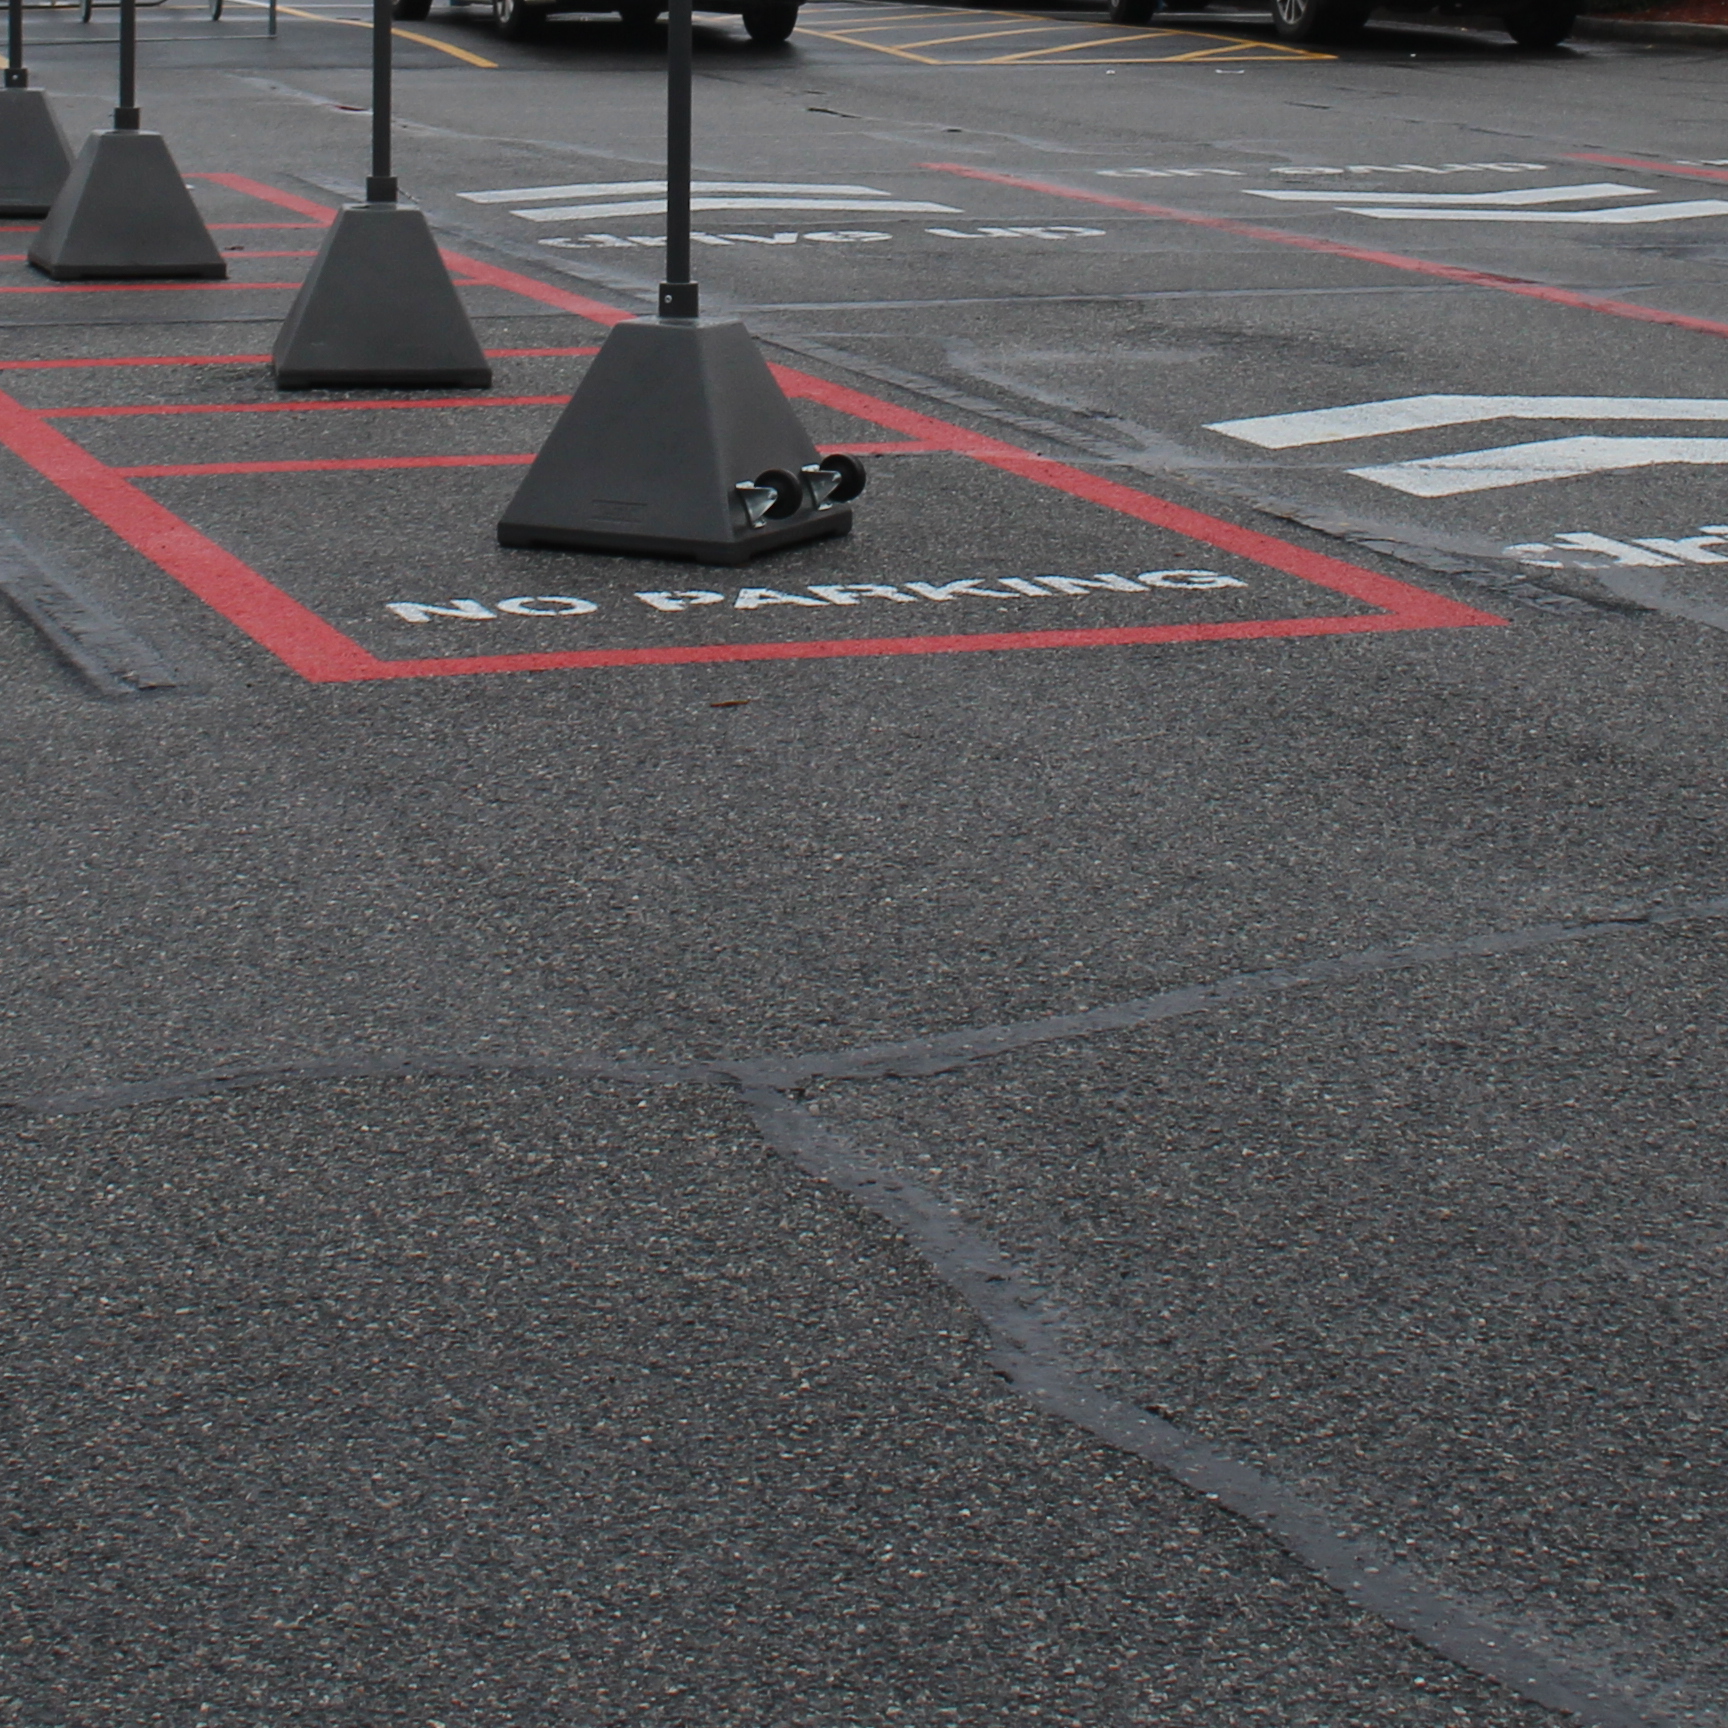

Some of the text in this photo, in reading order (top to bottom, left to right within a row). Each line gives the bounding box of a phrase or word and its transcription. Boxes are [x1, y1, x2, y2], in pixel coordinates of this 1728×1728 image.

[1271, 163, 1547, 174] drive
[538, 226, 1108, 248] drive up
[384, 568, 1250, 624] NO PARKING
